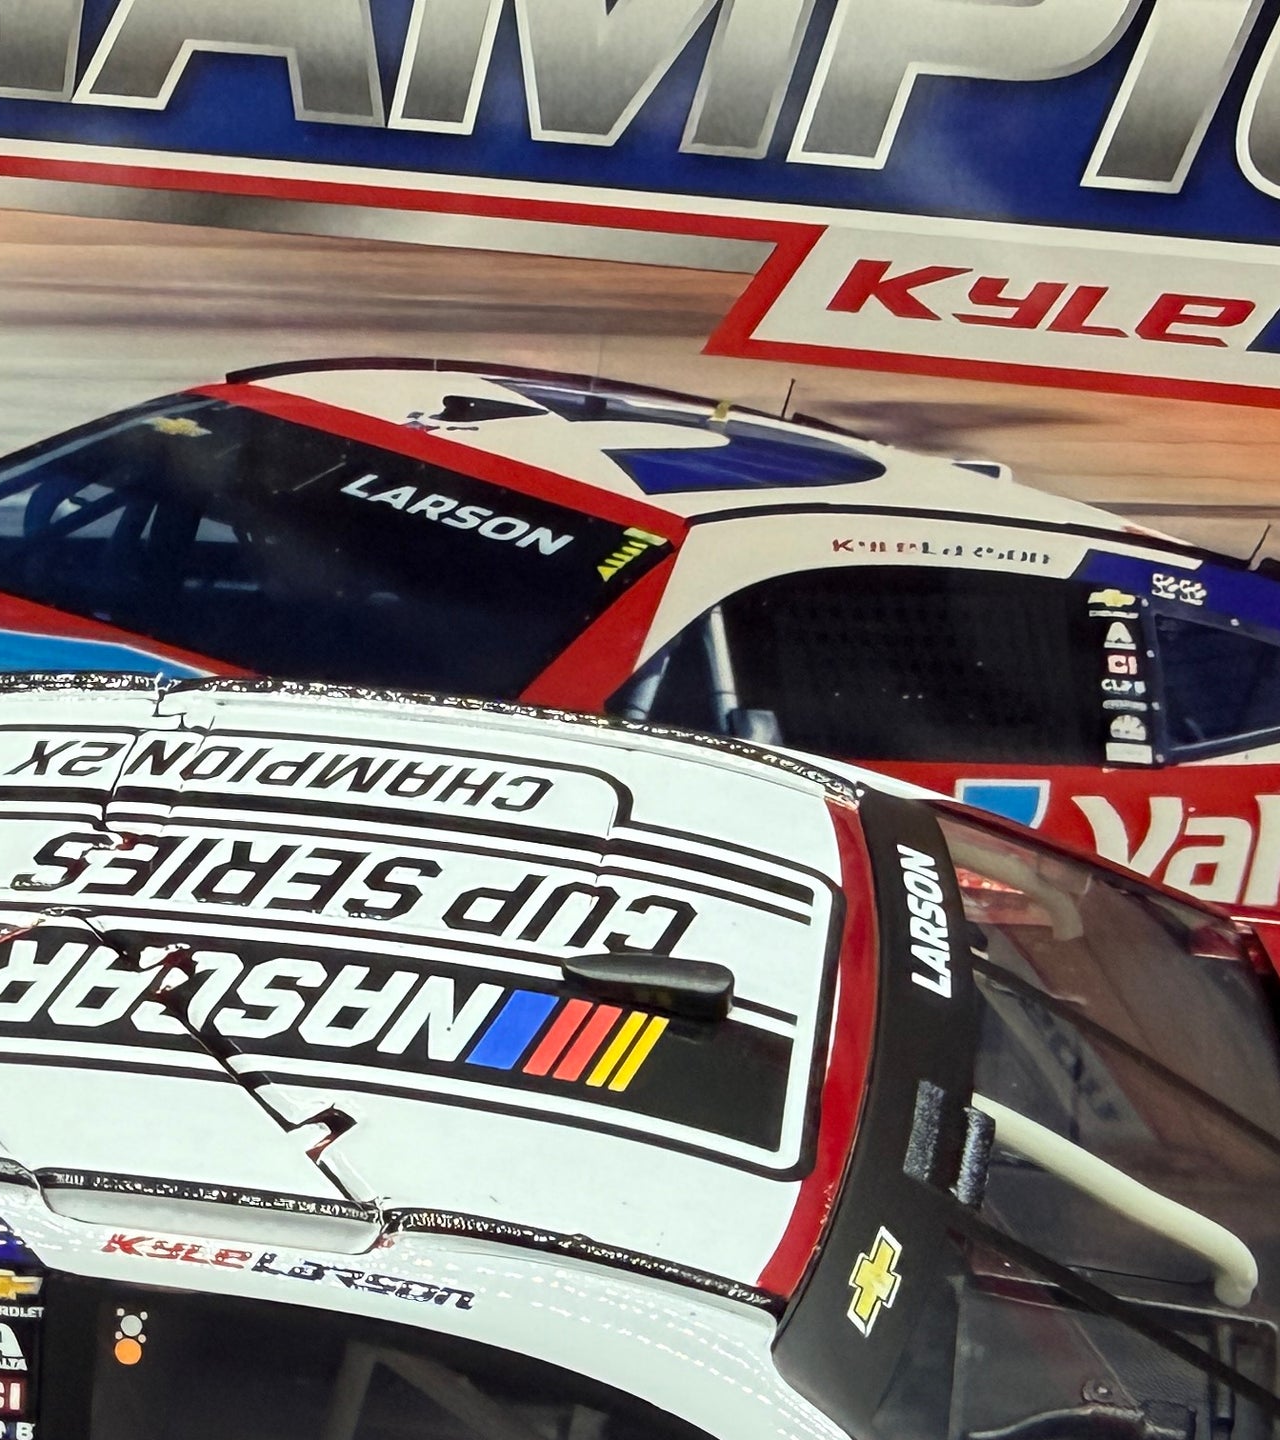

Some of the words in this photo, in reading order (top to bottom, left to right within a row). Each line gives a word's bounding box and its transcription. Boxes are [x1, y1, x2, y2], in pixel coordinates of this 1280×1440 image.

[339, 473, 574, 557] LARSON
[2, 738, 123, 778] 2X
[122, 737, 553, 813] CHAMPION
[9, 830, 442, 920] SERIES
[441, 870, 699, 958] CUP
[897, 844, 952, 999] LARSON
